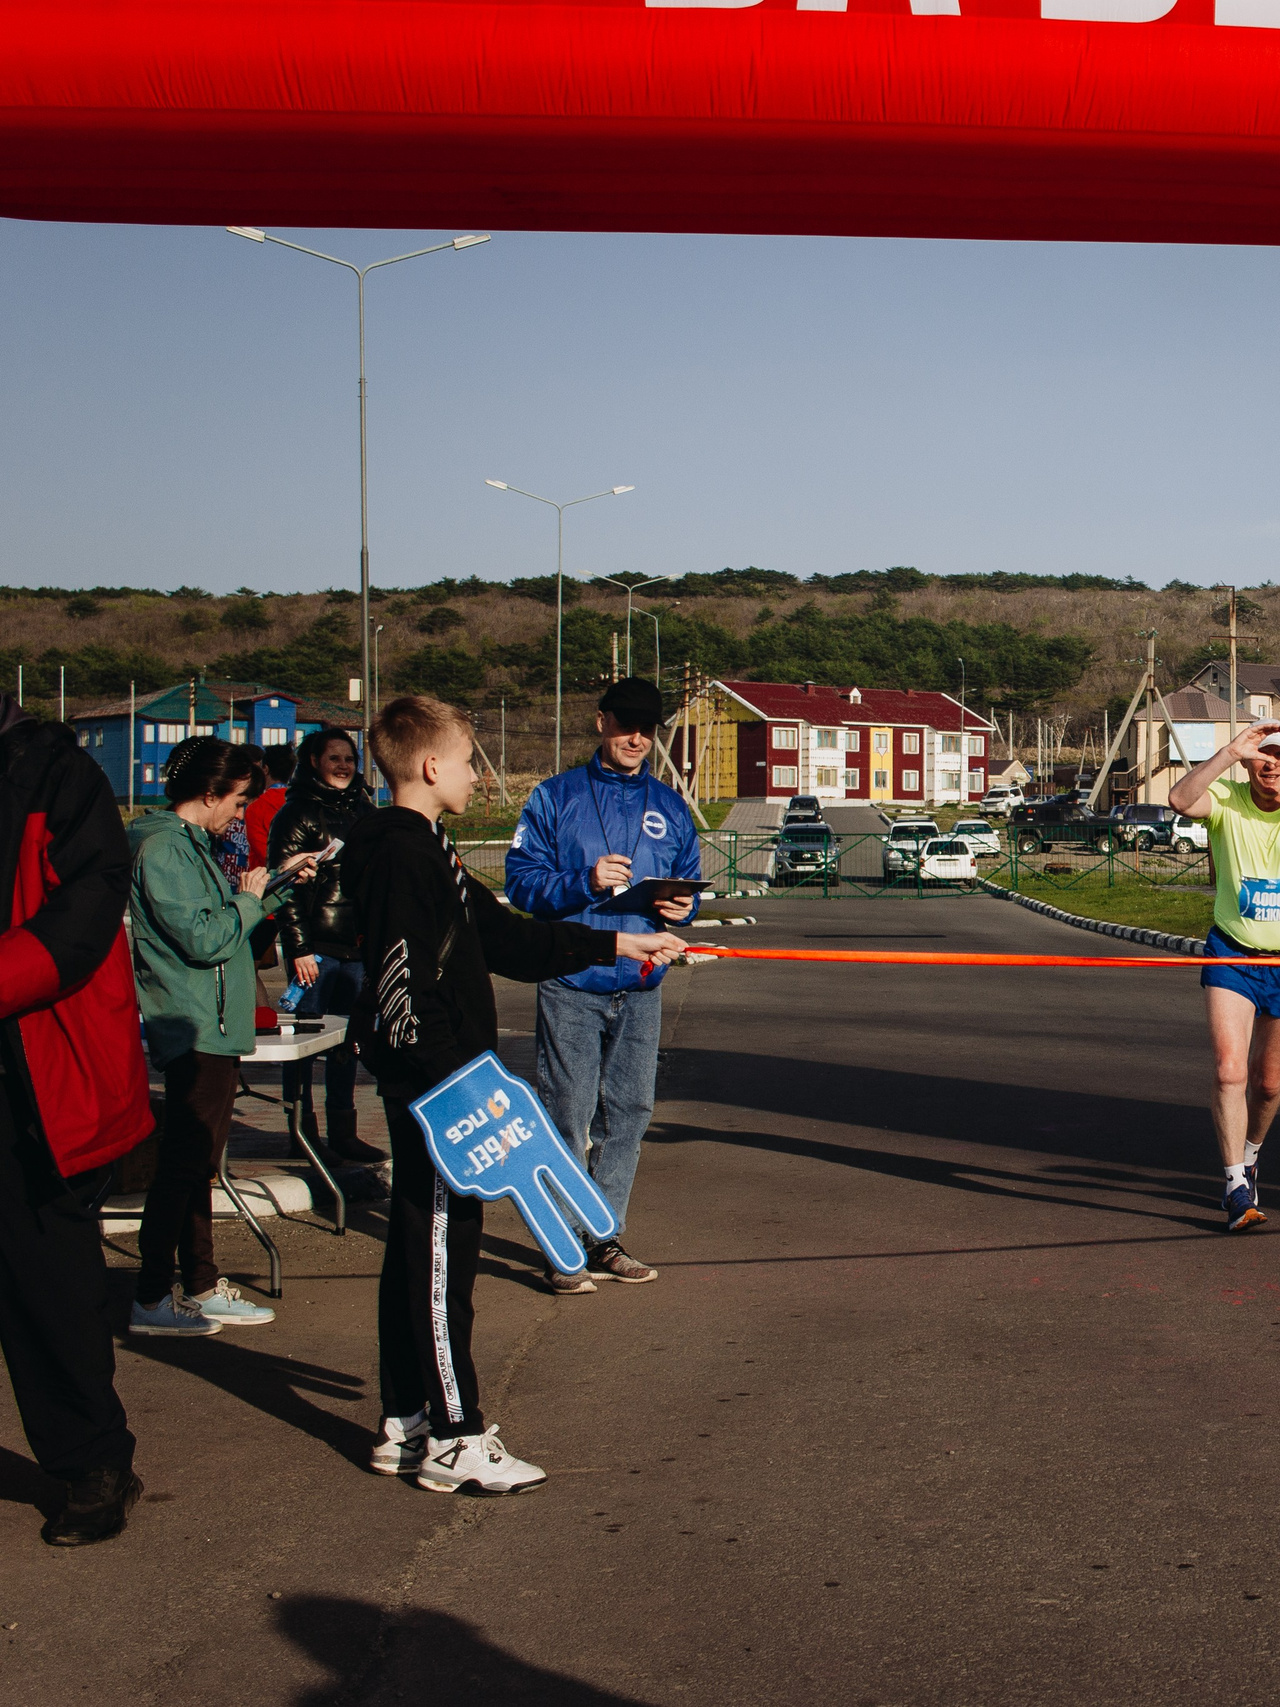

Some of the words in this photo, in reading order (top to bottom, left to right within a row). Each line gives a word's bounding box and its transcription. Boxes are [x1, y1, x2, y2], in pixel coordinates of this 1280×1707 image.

[445, 1108, 489, 1145] ПСБ
[435, 1194, 443, 1212] OPEN
[434, 1253, 442, 1285] YOURSELF
[438, 1346, 449, 1380] YOURSELF
[445, 1382, 453, 1400] OPEN
